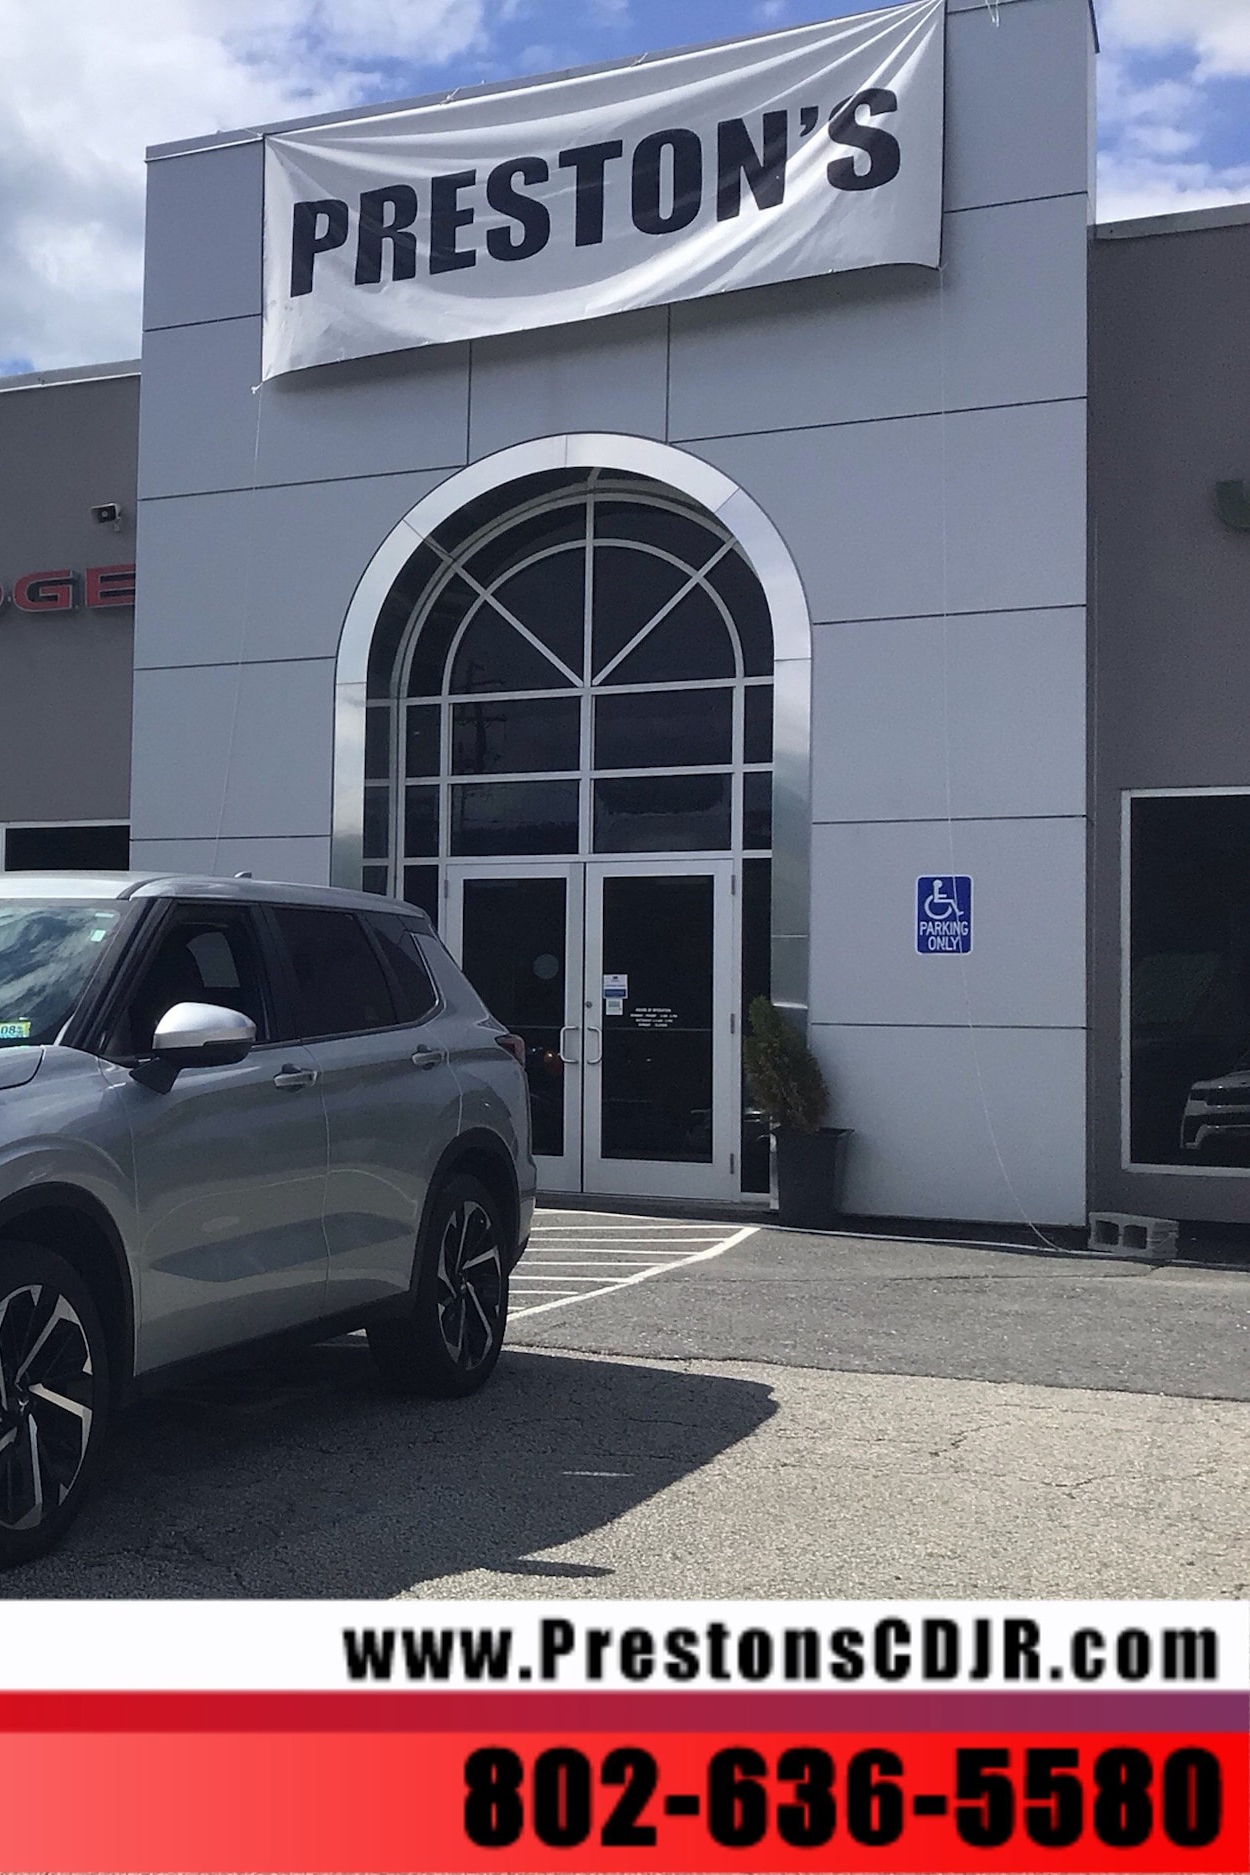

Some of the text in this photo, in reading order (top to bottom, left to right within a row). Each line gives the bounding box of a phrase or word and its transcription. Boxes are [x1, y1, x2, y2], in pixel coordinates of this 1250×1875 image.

[290, 88, 901, 297] PRESTON'S
[919, 921, 969, 936] PARKING
[928, 936, 959, 951] ONLY
